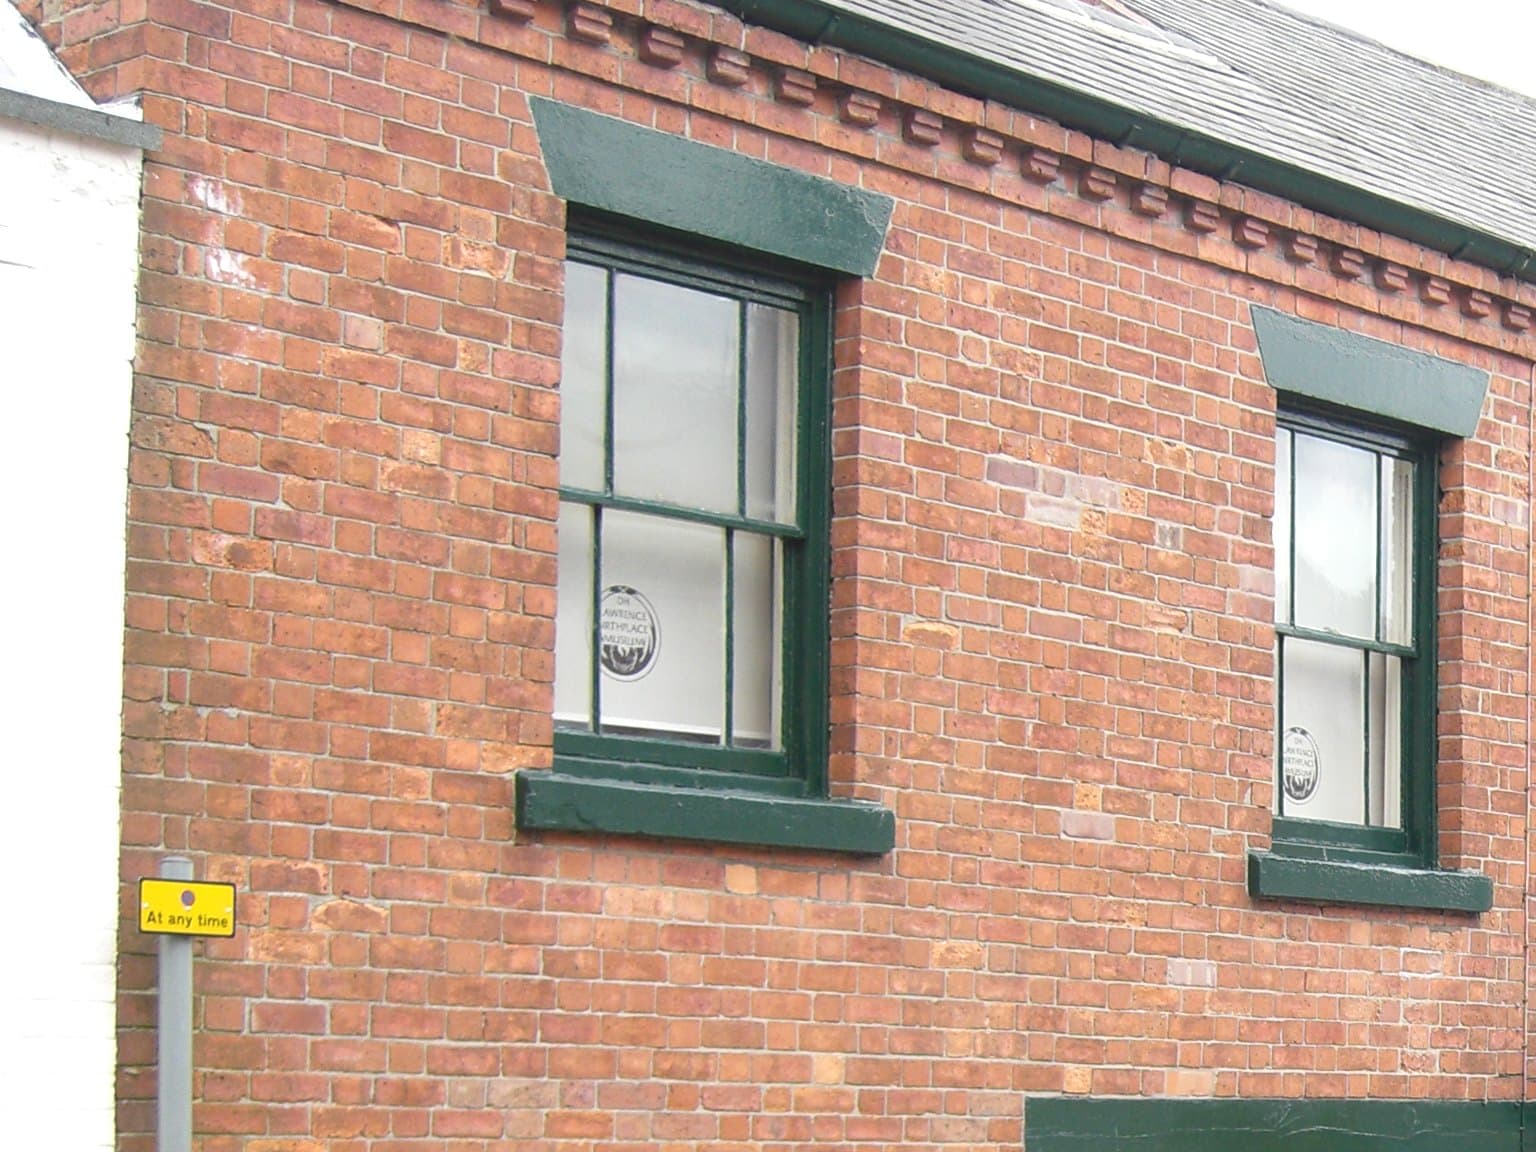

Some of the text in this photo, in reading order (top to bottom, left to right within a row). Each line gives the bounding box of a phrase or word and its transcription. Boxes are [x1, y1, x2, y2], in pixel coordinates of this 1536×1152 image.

[602, 608, 648, 621] AWRENCE
[146, 911, 228, 928] At any time
